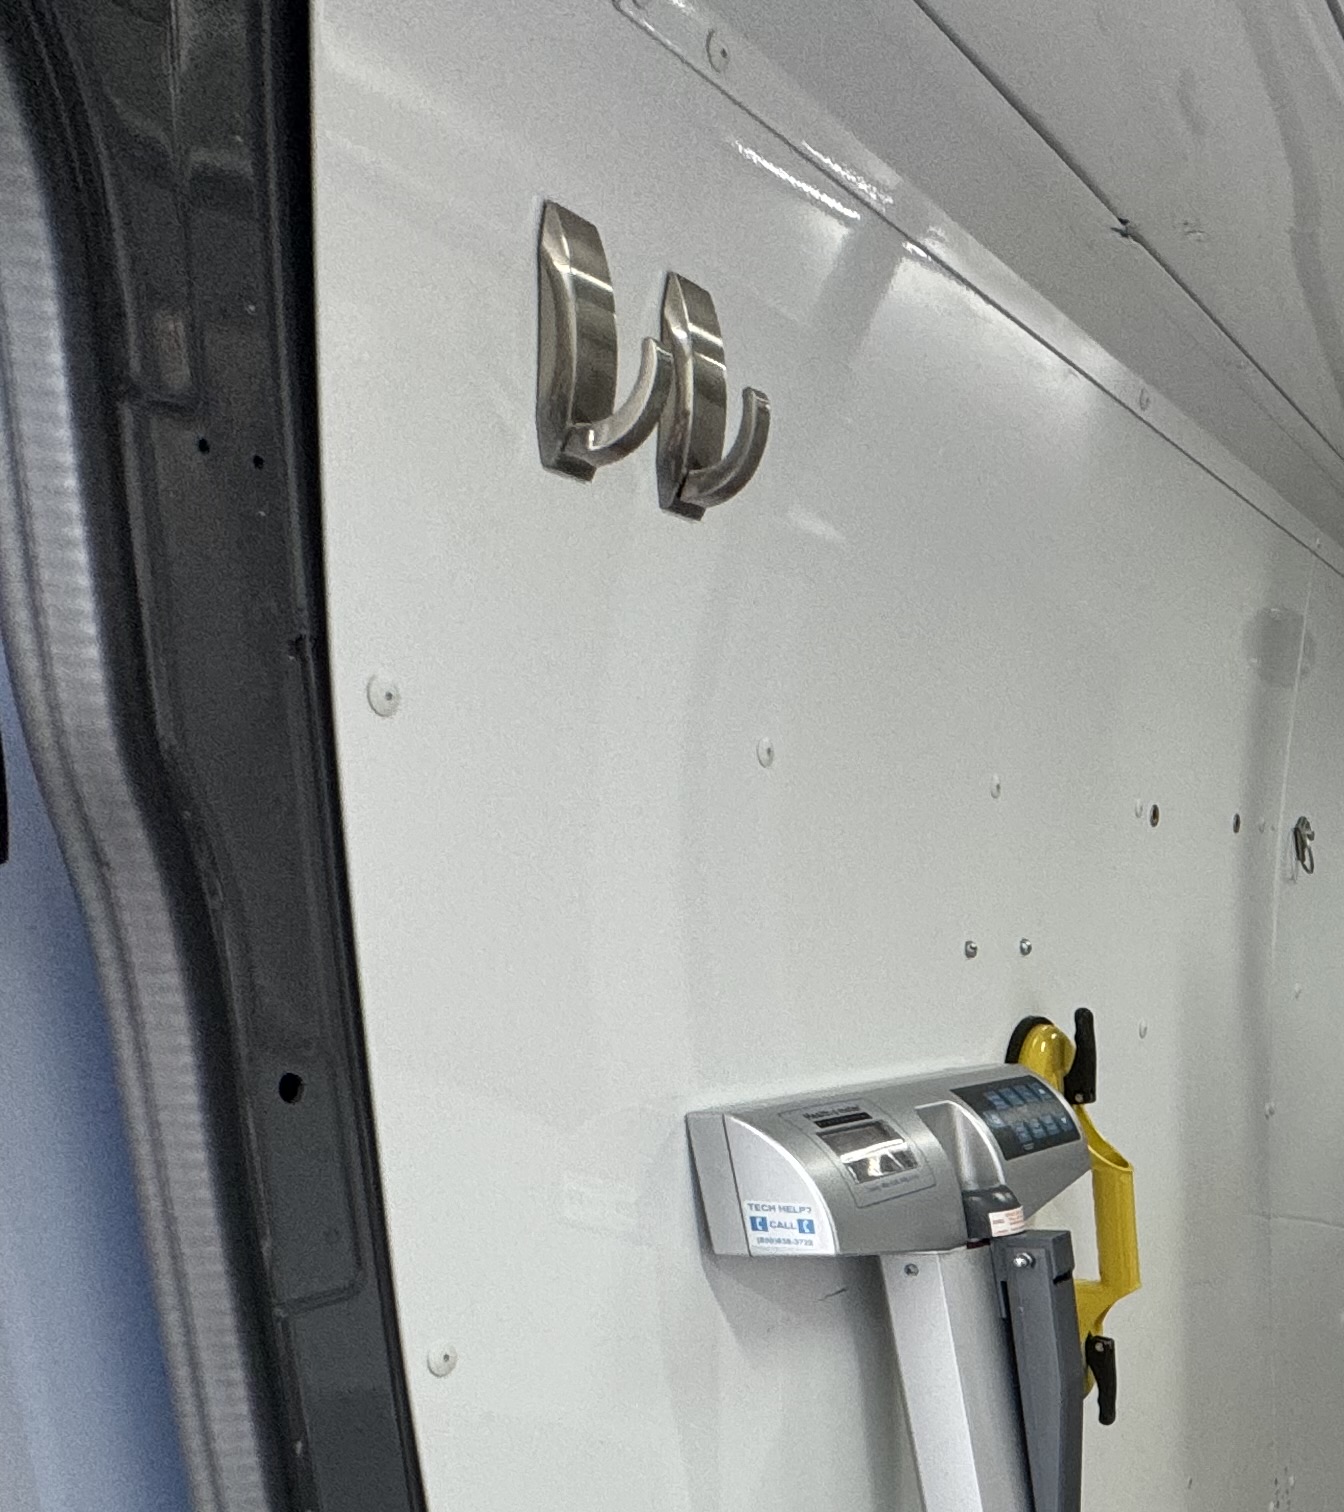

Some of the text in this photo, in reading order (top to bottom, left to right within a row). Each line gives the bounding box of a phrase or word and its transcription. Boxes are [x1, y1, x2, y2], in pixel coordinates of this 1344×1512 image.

[747, 1203, 812, 1214] TECH HELP?
[769, 1221, 797, 1230] CALL
